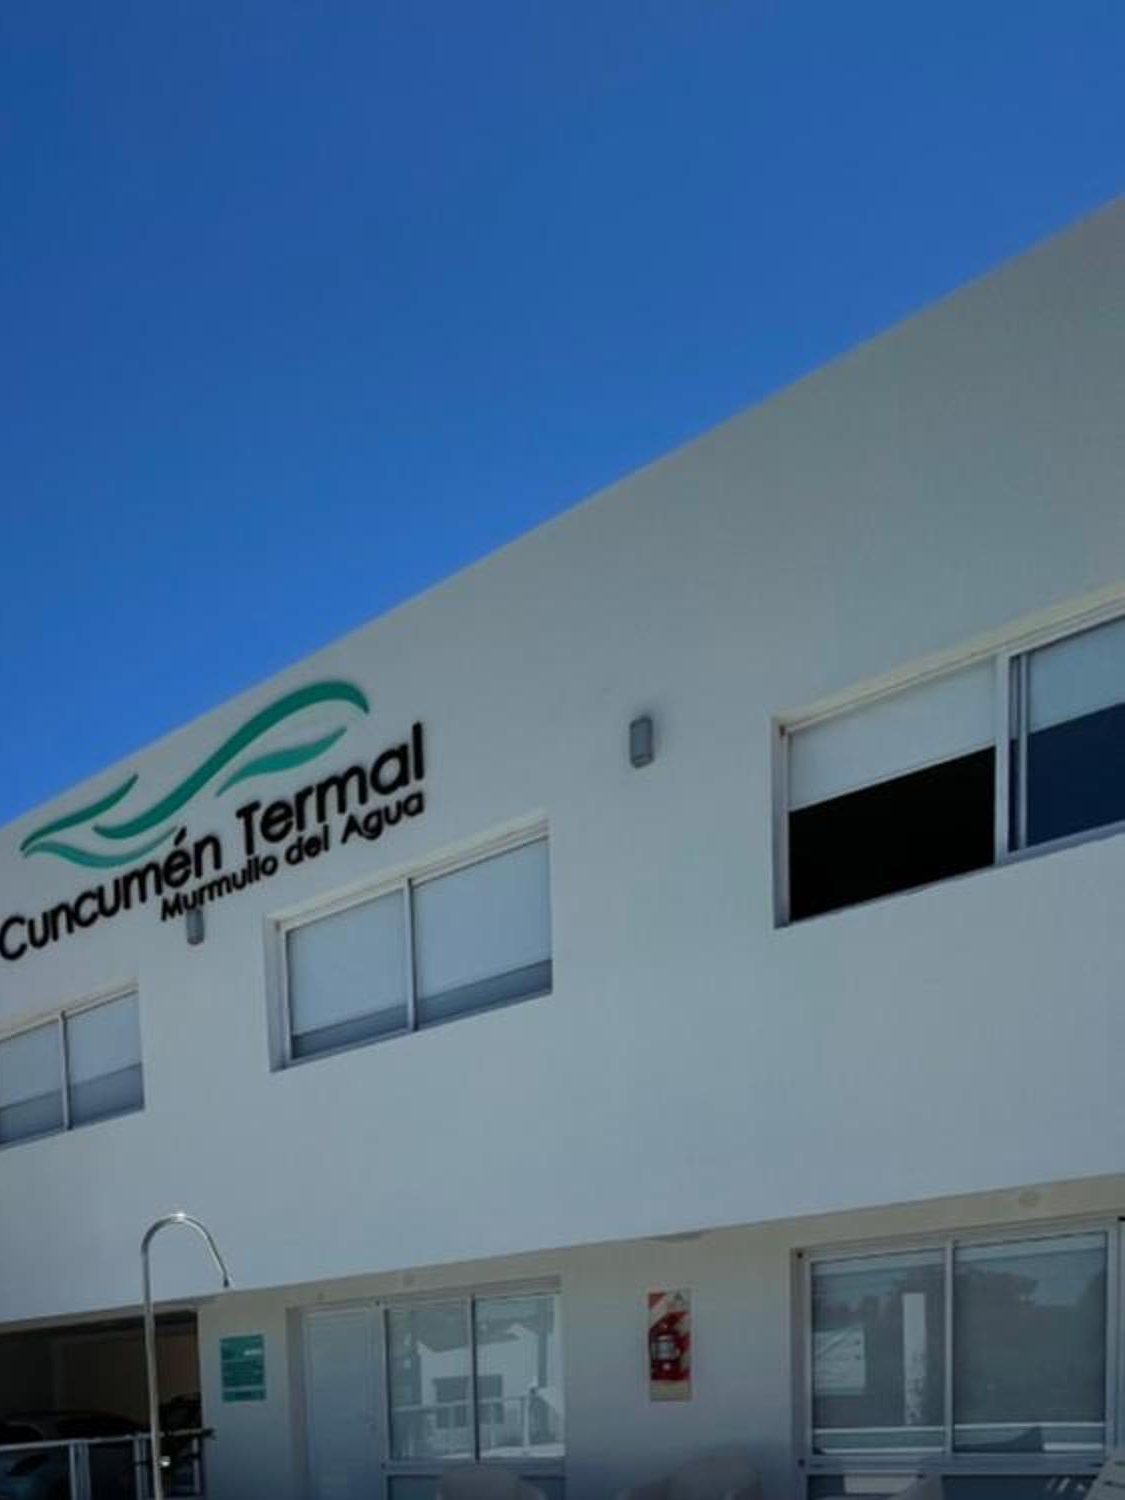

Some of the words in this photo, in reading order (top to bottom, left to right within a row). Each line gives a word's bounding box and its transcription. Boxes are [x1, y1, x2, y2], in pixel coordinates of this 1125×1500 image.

[236, 722, 425, 855] Termal
[160, 852, 278, 921] Murmullo
[285, 826, 330, 867] del
[340, 791, 425, 844] Agua
